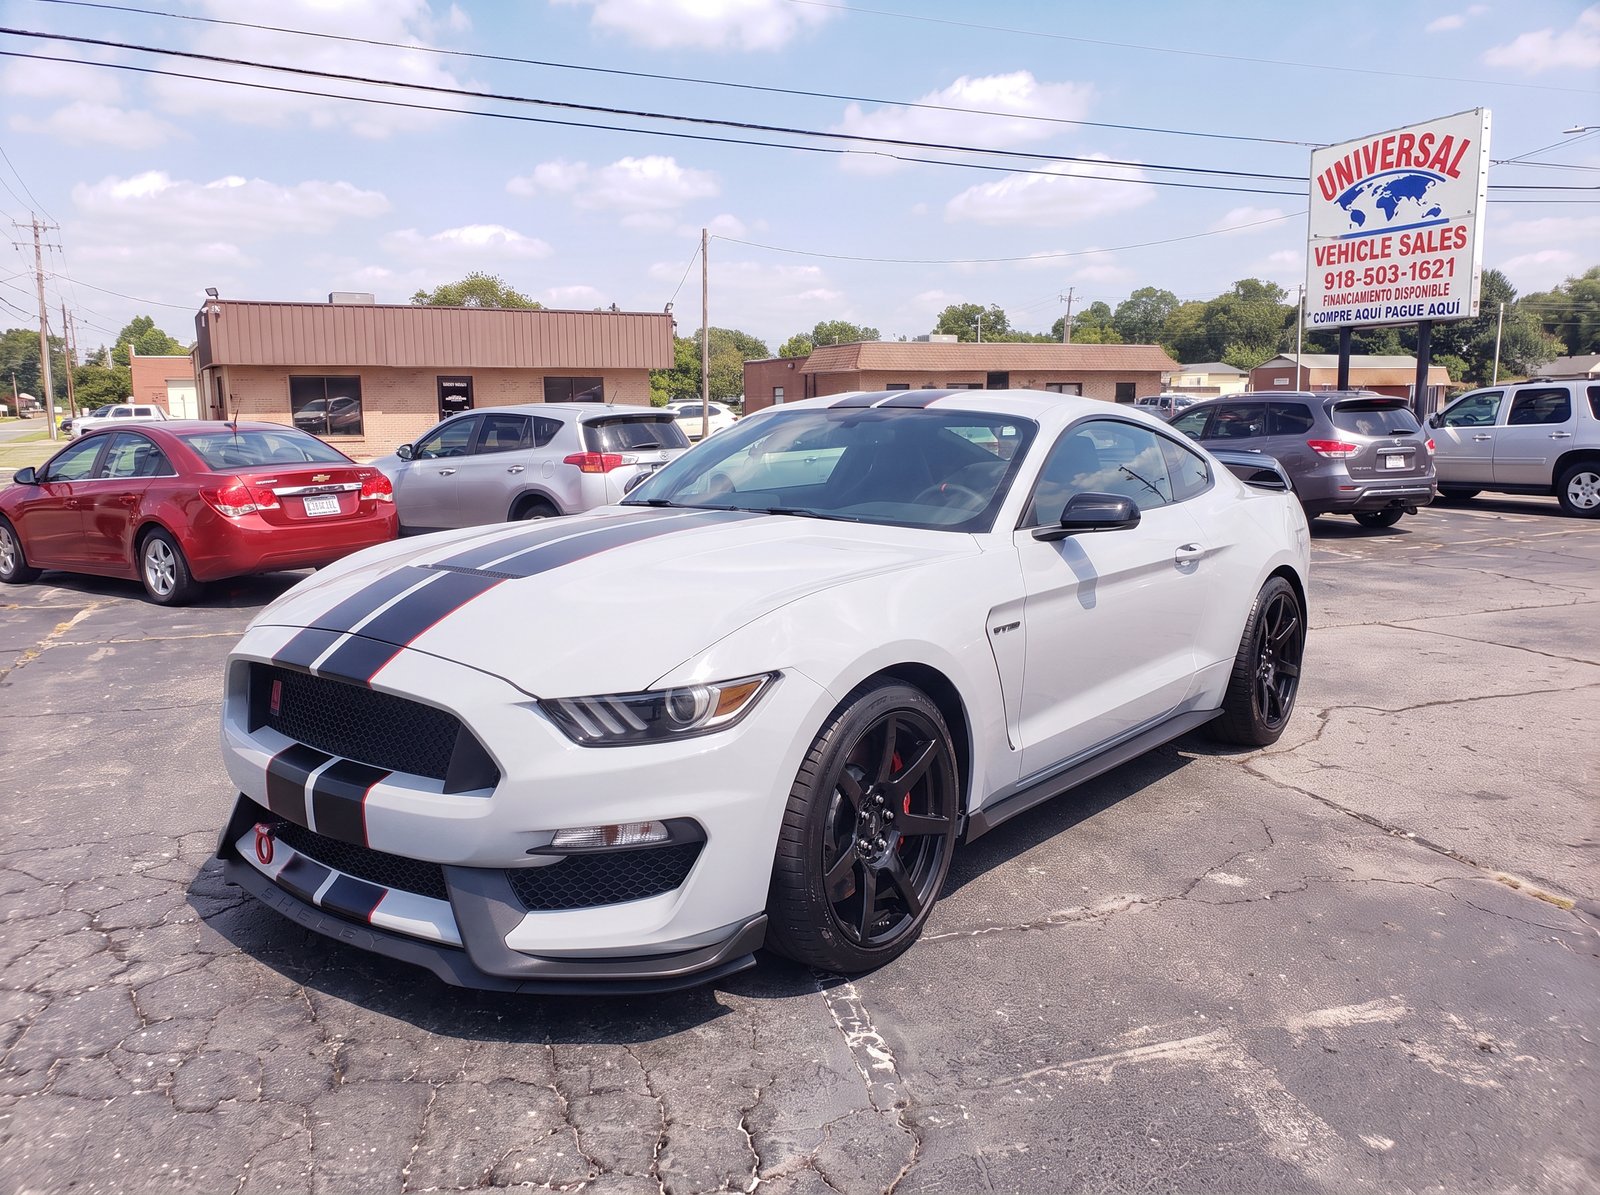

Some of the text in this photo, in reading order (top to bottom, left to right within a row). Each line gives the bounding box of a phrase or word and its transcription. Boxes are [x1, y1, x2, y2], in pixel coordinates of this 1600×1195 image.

[1317, 132, 1471, 202] UNIVERSAL
[1314, 225, 1467, 267] VEHICLE SALES
[1324, 257, 1456, 290] 918-503-1621
[1313, 298, 1461, 324] COMPRE AQUÍ PAGUE AQUÍ
[1322, 282, 1450, 307] FINANCIAMIENTO DISPONIBLE
[261, 886, 387, 949] SHELBY
